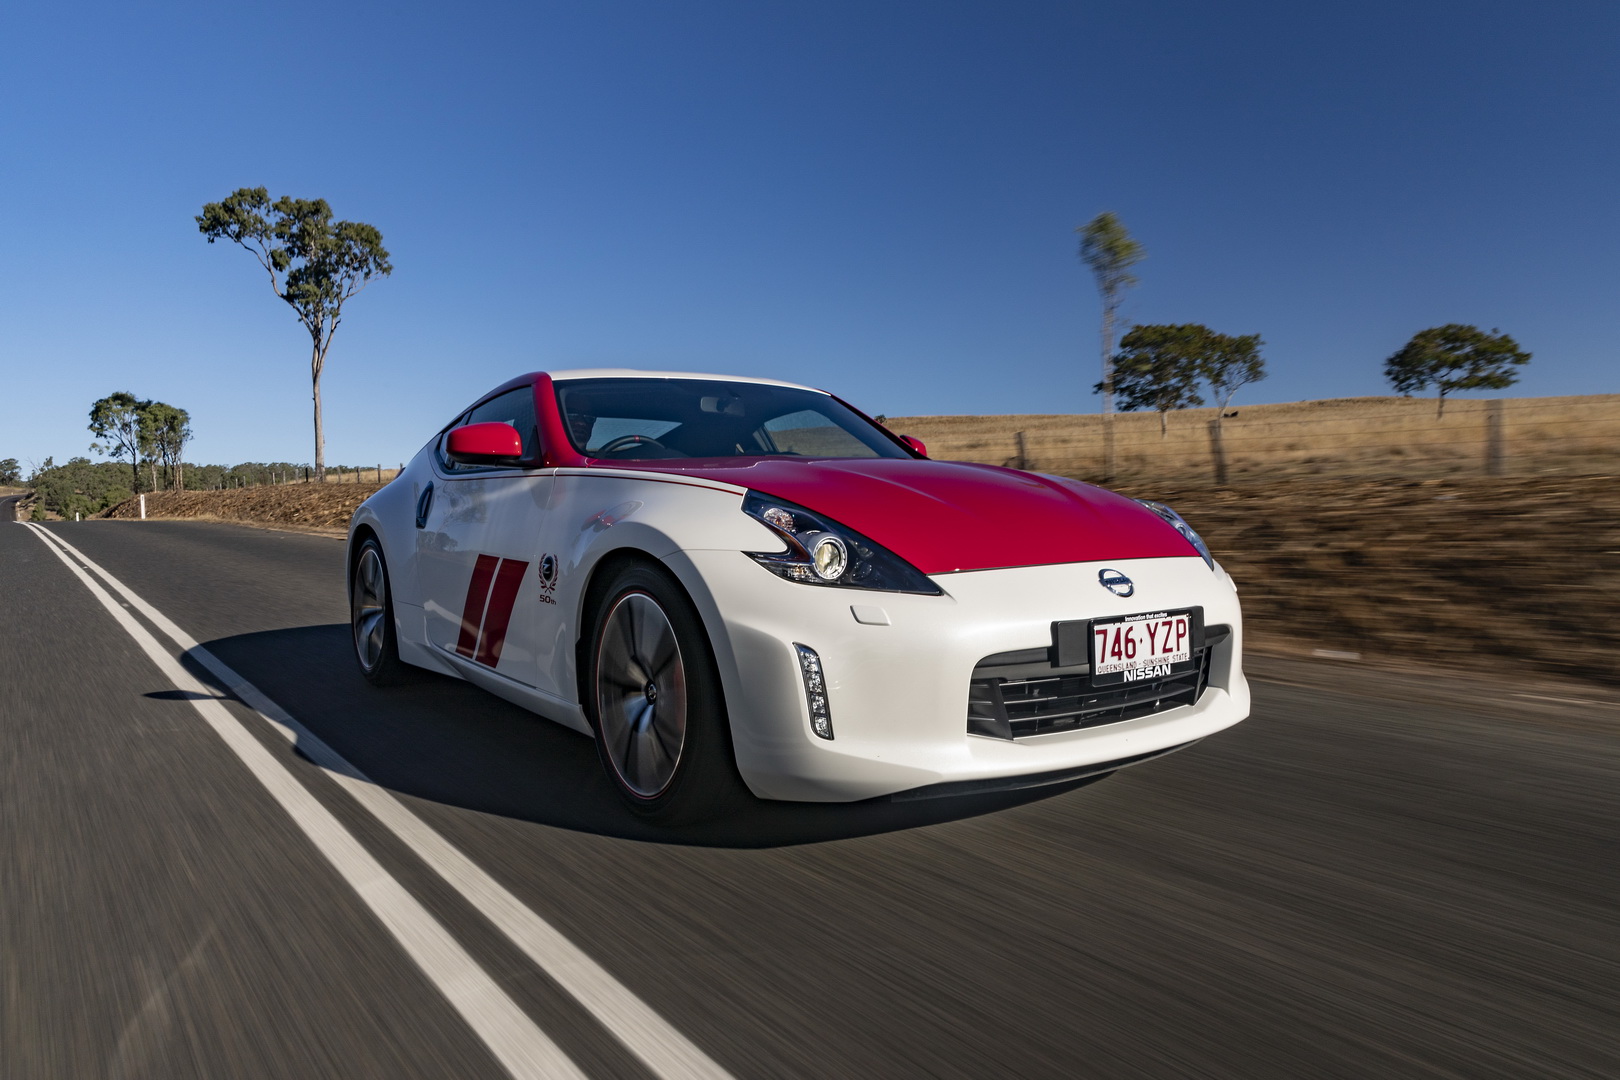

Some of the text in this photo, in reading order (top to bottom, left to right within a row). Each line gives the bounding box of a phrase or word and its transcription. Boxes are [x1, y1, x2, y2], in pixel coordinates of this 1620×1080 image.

[540, 594, 556, 605] 50th
[1098, 660, 1138, 674] QUEENSLAND
[1142, 656, 1170, 667] SUNSHINE
[1172, 652, 1188, 662] STATE
[1124, 664, 1171, 682] NISSAN
